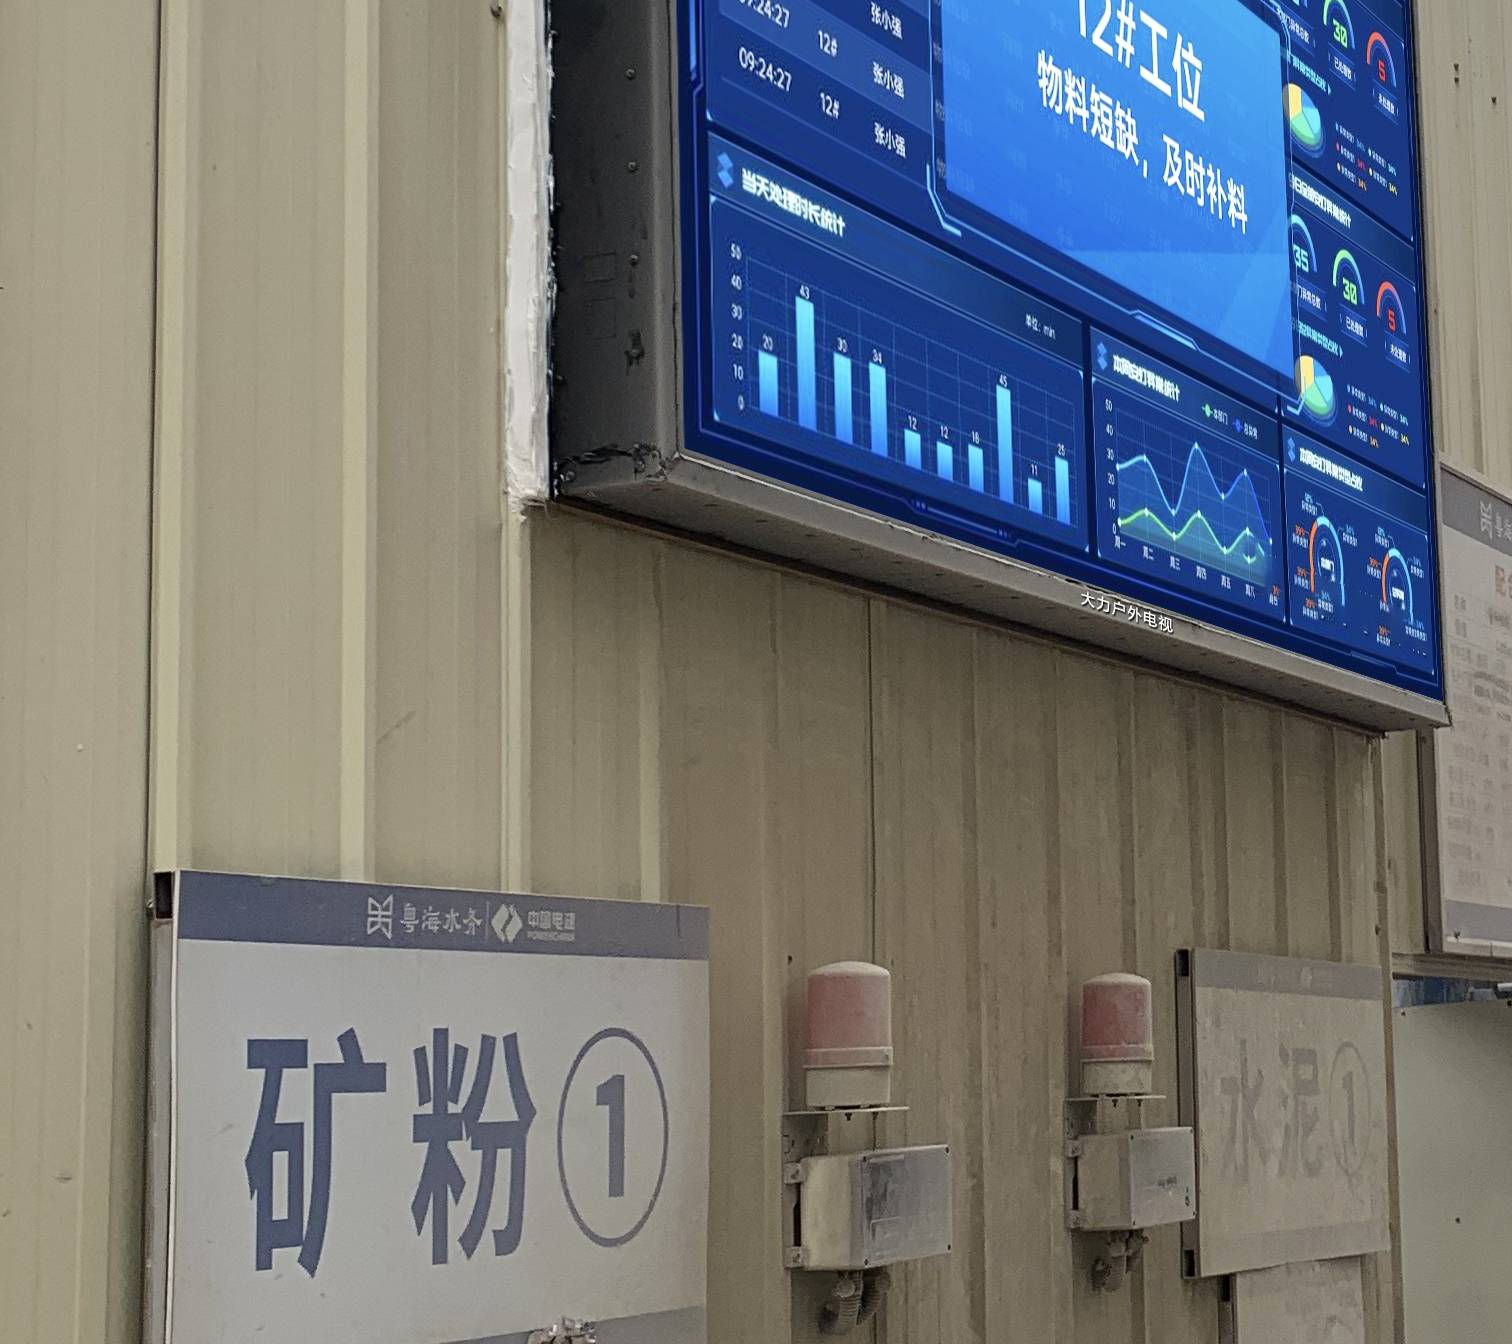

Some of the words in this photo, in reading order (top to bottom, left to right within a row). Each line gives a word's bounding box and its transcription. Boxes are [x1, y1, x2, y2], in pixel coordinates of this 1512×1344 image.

[817, 27, 837, 59] 12#
[872, 59, 904, 99] 张小强
[1332, 17, 1347, 49] 30
[1378, 58, 1385, 83] 5
[739, 43, 791, 94] 09:24:27
[820, 90, 840, 121] 12#
[873, 119, 905, 159] 张小强
[1037, 46, 1247, 240] 物料短缺，及时补料
[1293, 242, 1308, 273] 35
[1342, 276, 1357, 306] 30
[1387, 308, 1395, 333] 5
[733, 362, 744, 383] 10
[762, 333, 773, 353] 20
[1108, 496, 1115, 511] 10
